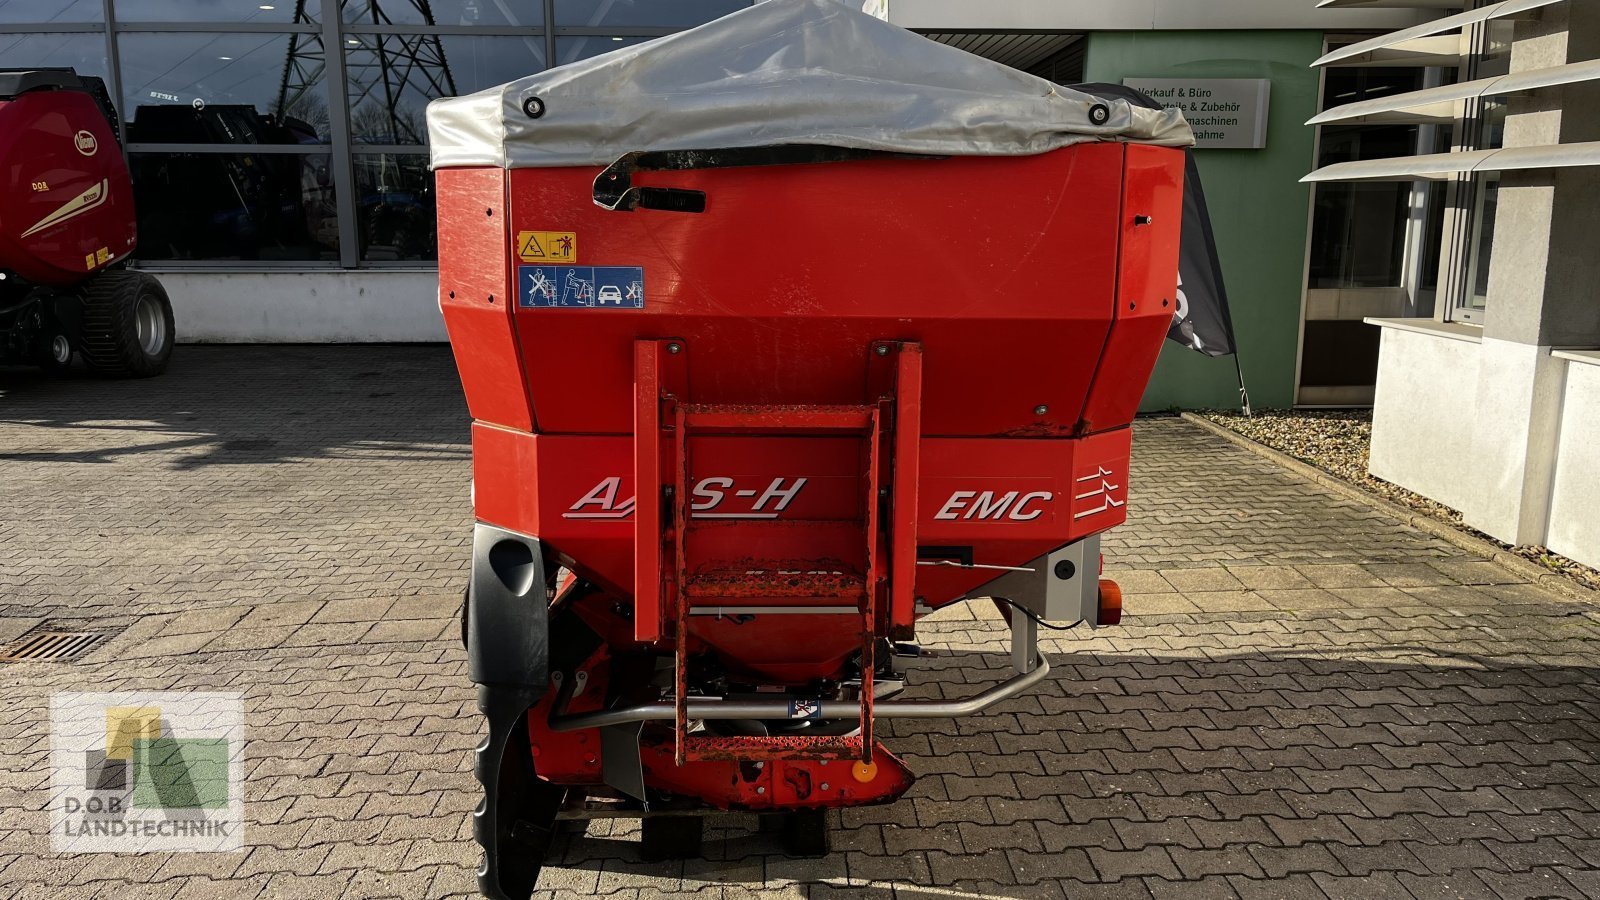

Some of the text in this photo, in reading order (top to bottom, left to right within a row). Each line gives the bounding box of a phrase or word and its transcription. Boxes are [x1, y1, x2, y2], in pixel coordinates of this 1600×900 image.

[1177, 87, 1186, 98] &
[1188, 87, 1212, 98] Büro
[1189, 101, 1198, 112] &
[1200, 101, 1241, 112] Zubehör
[1187, 115, 1238, 126] maschinen
[1193, 129, 1225, 140] nahme
[568, 476, 808, 511] AS-H
[933, 490, 1053, 521] EMC
